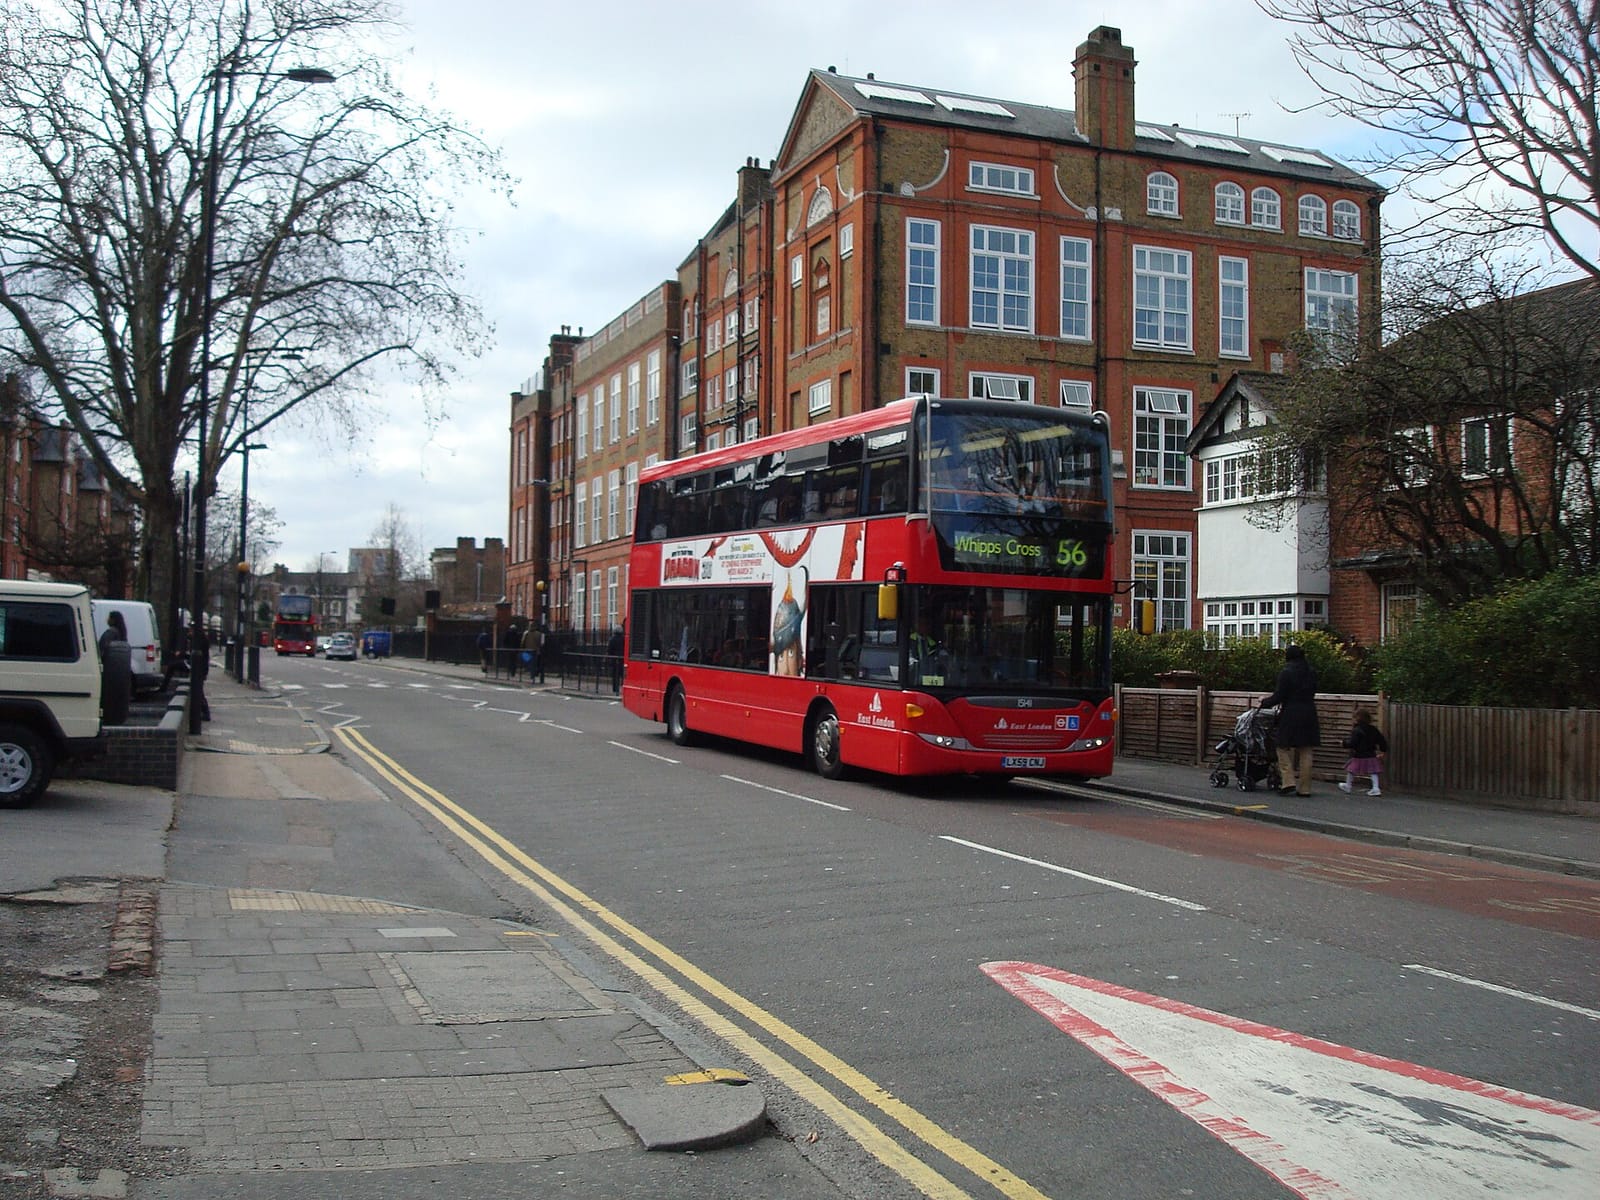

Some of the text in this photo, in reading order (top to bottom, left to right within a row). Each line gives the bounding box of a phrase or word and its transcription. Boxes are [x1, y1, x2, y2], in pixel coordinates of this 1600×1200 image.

[955, 536, 1042, 558] Whipps Cross
[1057, 539, 1087, 566] 56
[857, 712, 896, 728] East London
[1009, 722, 1053, 730] East London
